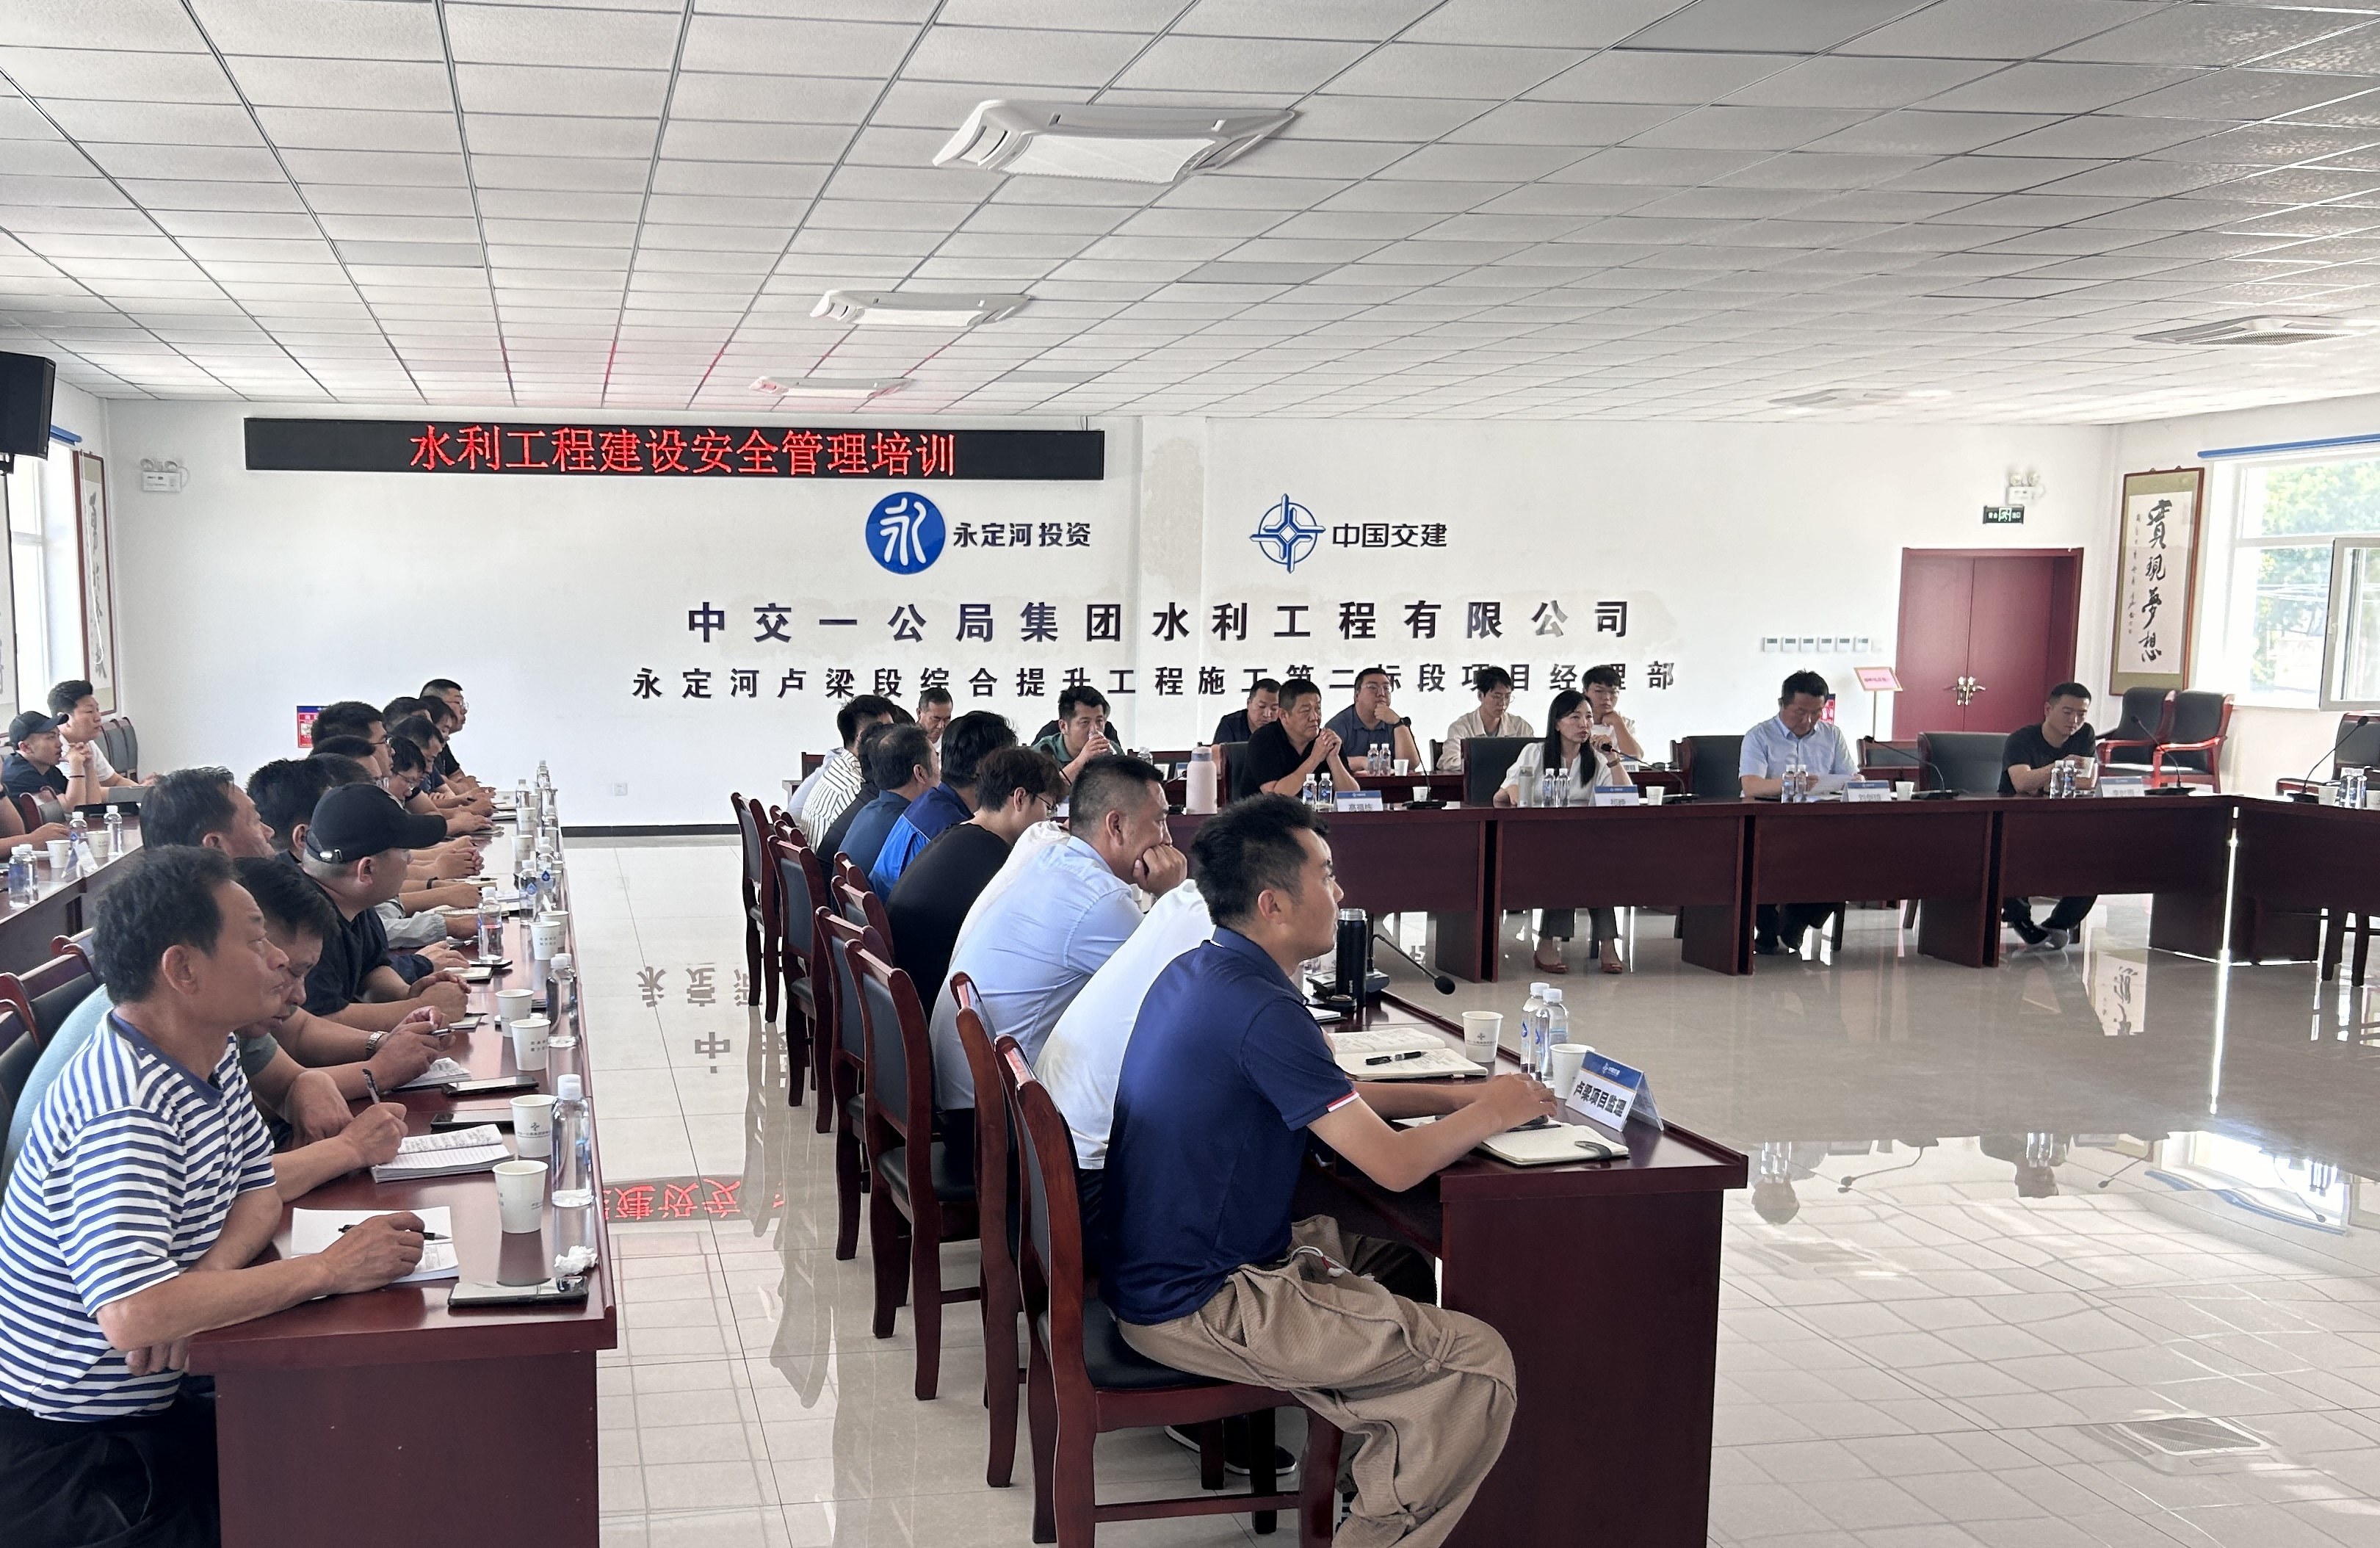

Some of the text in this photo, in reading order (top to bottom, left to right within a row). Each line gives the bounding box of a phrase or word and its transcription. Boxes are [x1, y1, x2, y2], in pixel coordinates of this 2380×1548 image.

[410, 424, 955, 477] 水利工程建设安全管理培训
[953, 521, 1092, 549] 永定河投资
[1331, 522, 1448, 549] 中国交建
[687, 600, 1630, 644] 中交一公局集团水利工程有限公司
